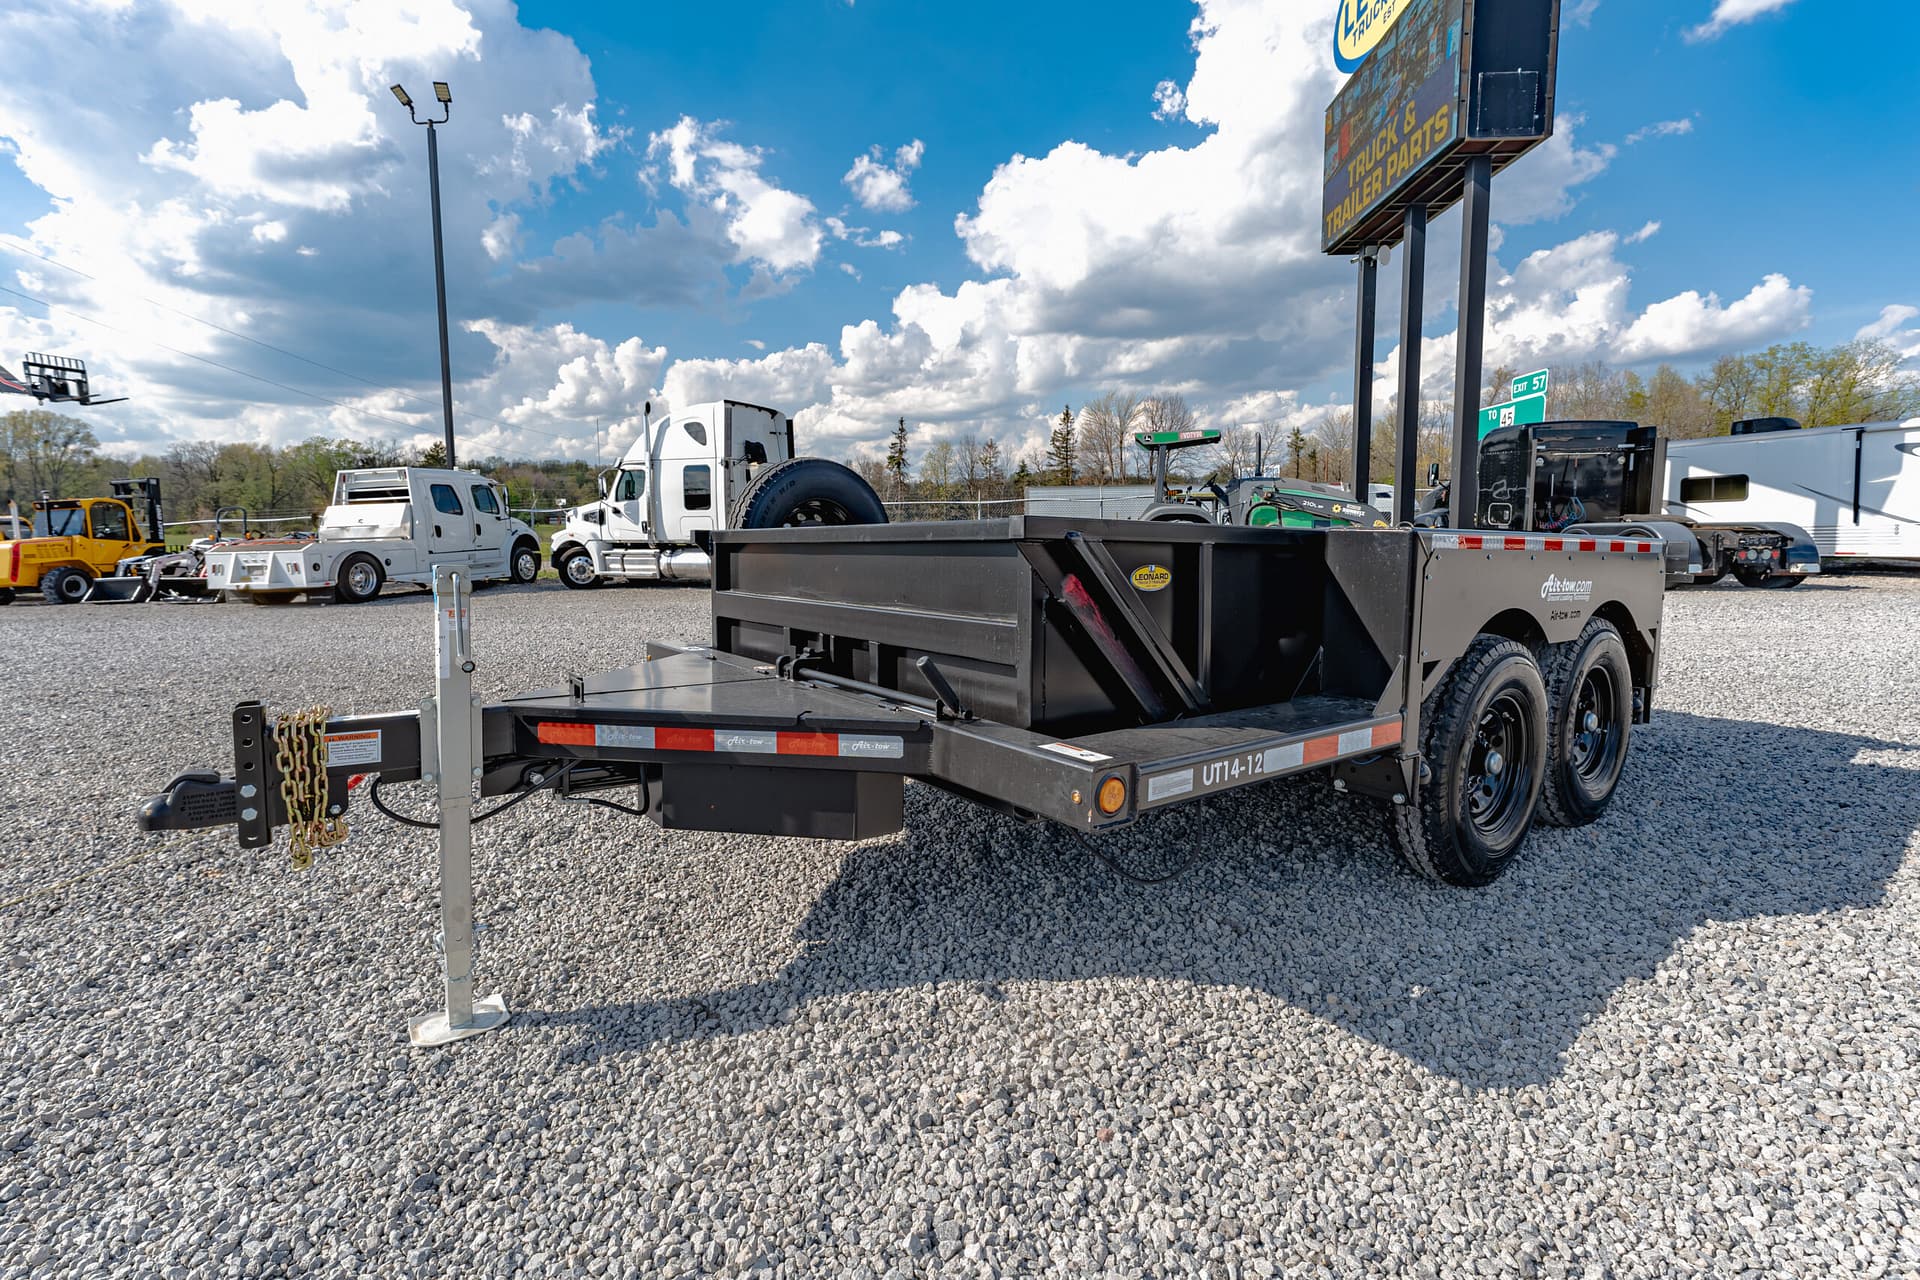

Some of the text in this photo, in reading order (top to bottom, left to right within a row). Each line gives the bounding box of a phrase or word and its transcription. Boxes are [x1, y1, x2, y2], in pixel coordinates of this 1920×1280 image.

[1348, 101, 1416, 188] TRUCK &
[1326, 104, 1449, 238] TRAILER PARTS
[1513, 374, 1546, 394] EXIT 57
[1488, 410, 1513, 425] TO 45
[1135, 573, 1169, 581] LEONARD
[1203, 753, 1262, 785] UT14-12
